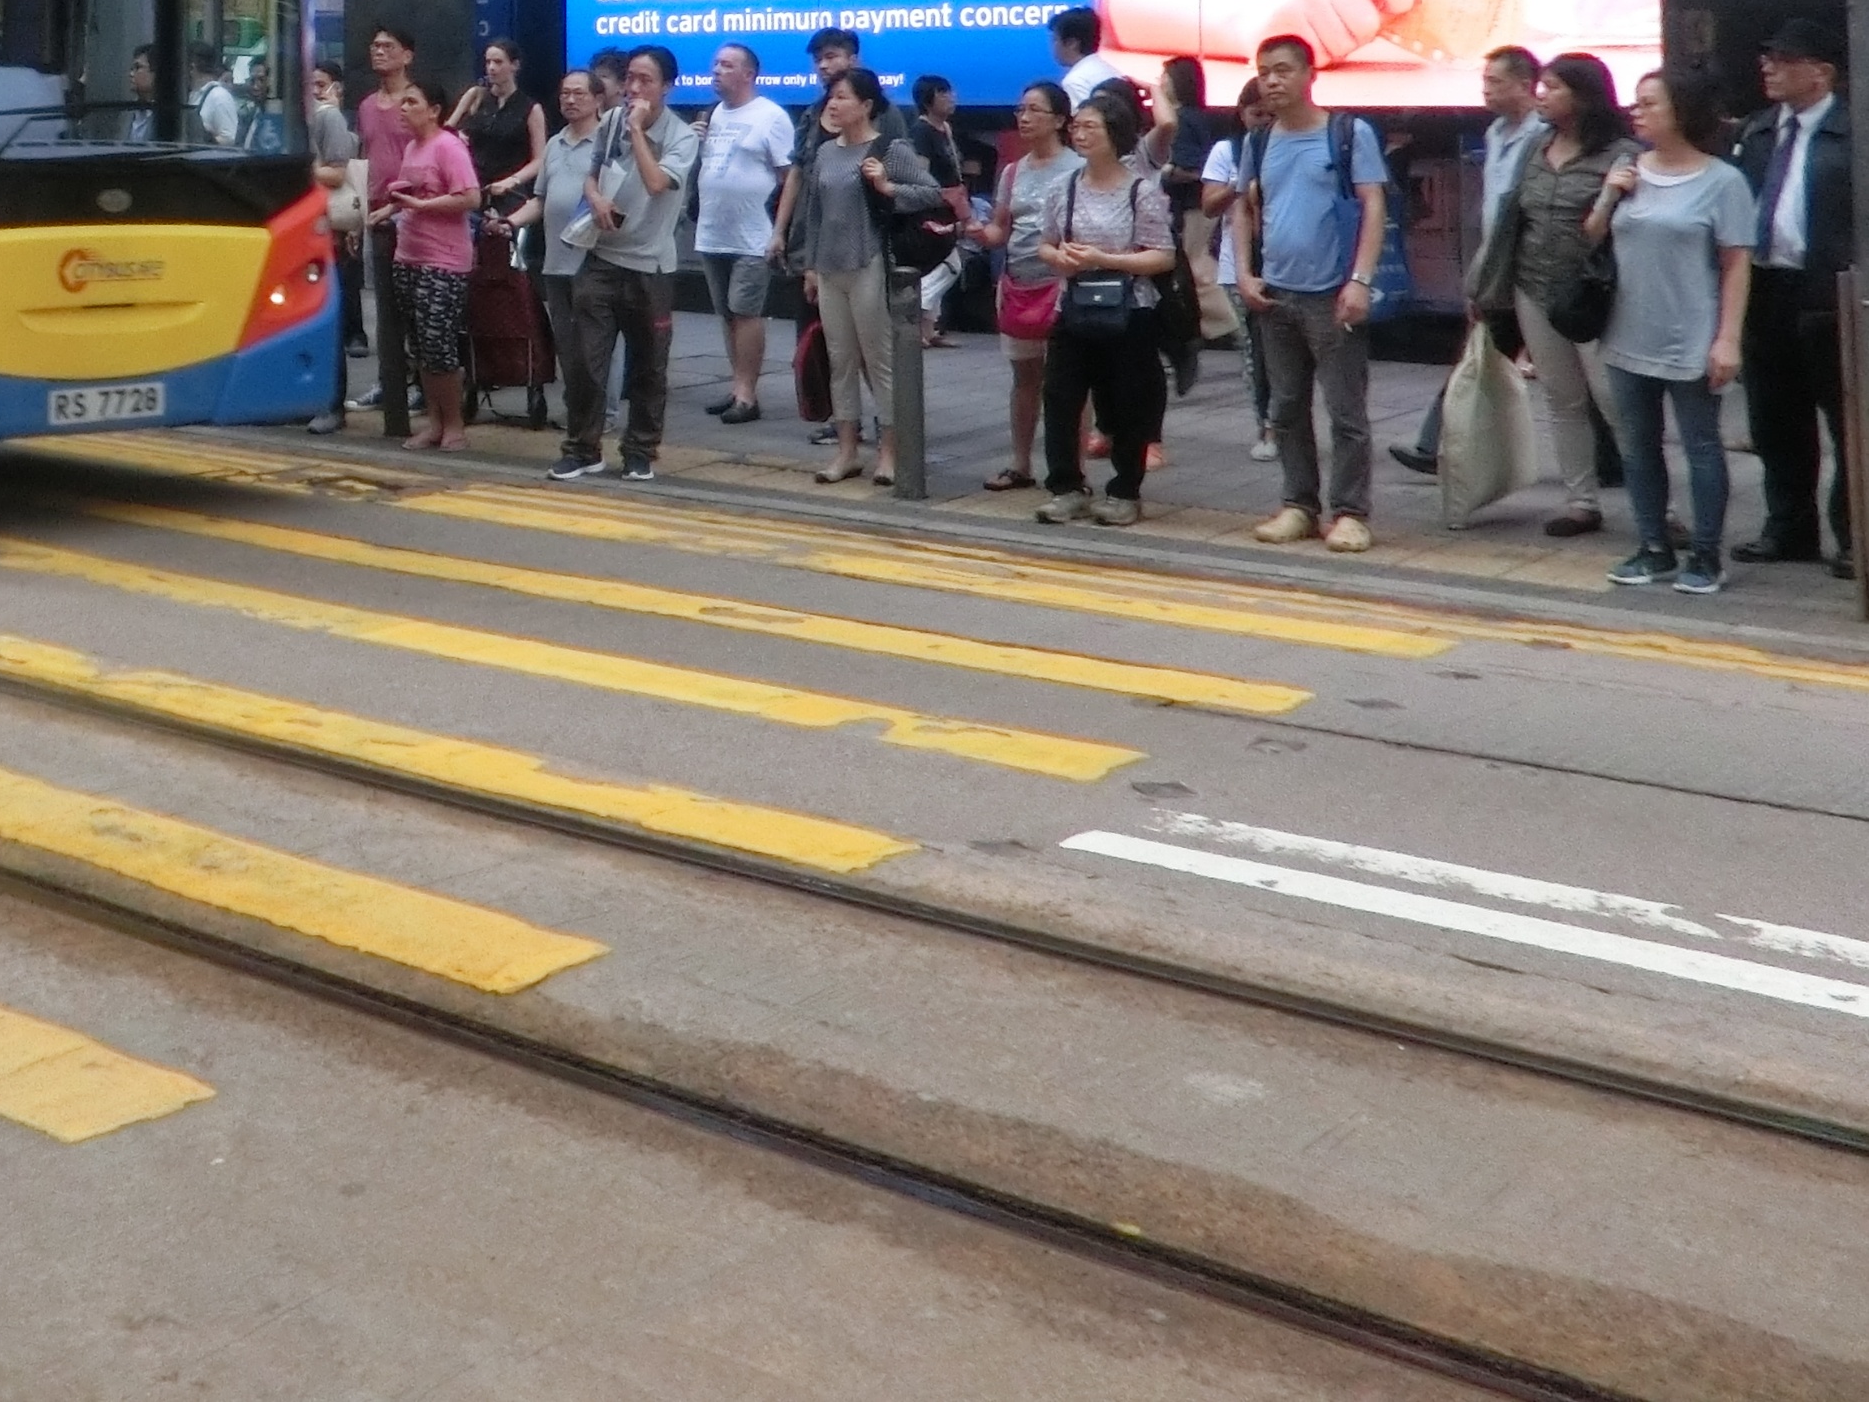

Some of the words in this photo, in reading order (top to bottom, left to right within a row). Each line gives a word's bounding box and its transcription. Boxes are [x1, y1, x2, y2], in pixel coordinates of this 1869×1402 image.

[596, 10, 660, 35] credit
[666, 9, 717, 33] card
[723, 8, 832, 31] minimum
[840, 3, 952, 34] payment
[695, 74, 713, 86] bor
[755, 75, 781, 86] rrow
[783, 73, 807, 88] only
[55, 393, 87, 420] RS
[97, 387, 158, 417] 7728
